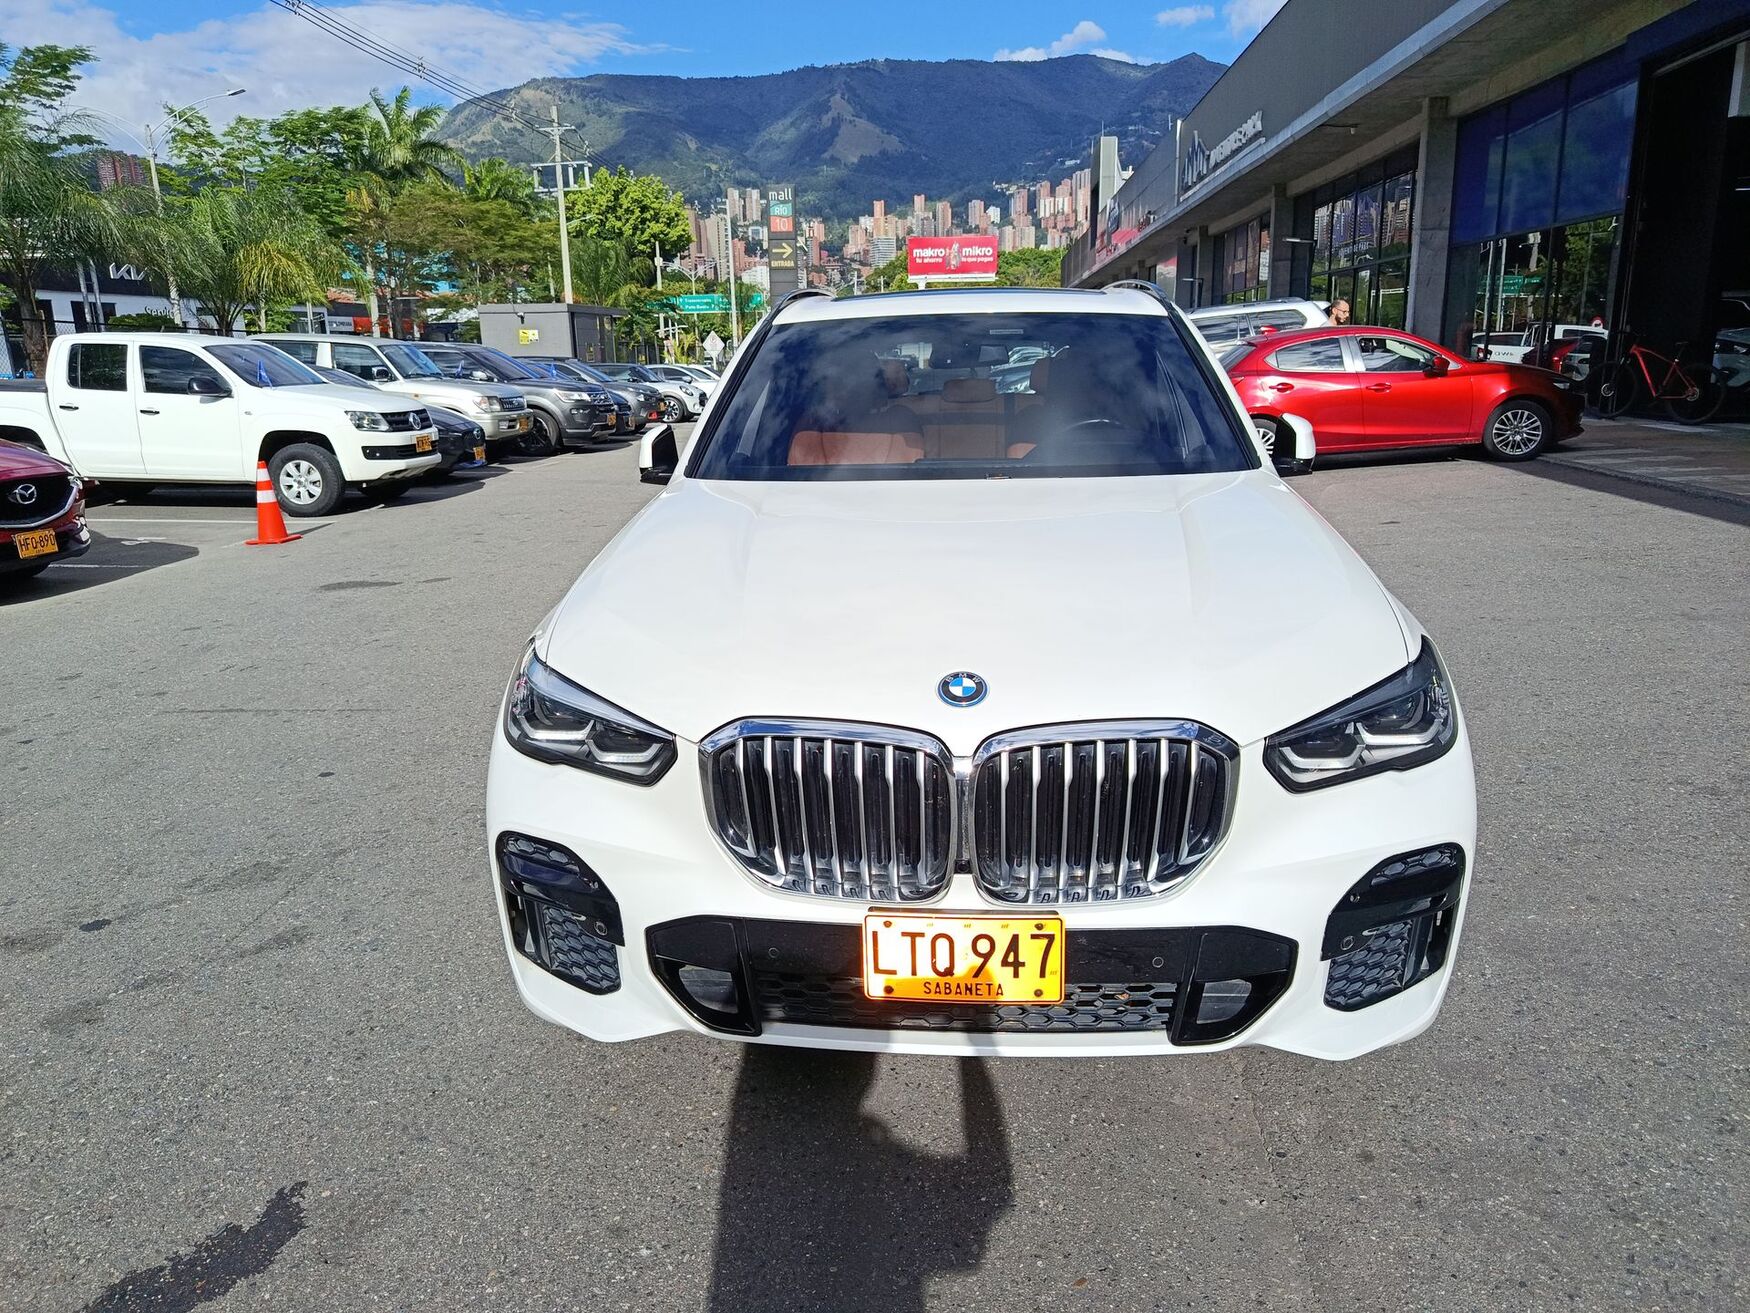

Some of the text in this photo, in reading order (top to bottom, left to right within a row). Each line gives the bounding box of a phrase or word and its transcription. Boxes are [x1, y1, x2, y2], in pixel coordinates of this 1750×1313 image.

[768, 188, 793, 201] mall
[776, 218, 788, 231] 10
[912, 247, 945, 257] makro
[962, 245, 993, 256] mikro
[872, 931, 1055, 979] LTQ 947
[923, 981, 1004, 996] SABANETA
